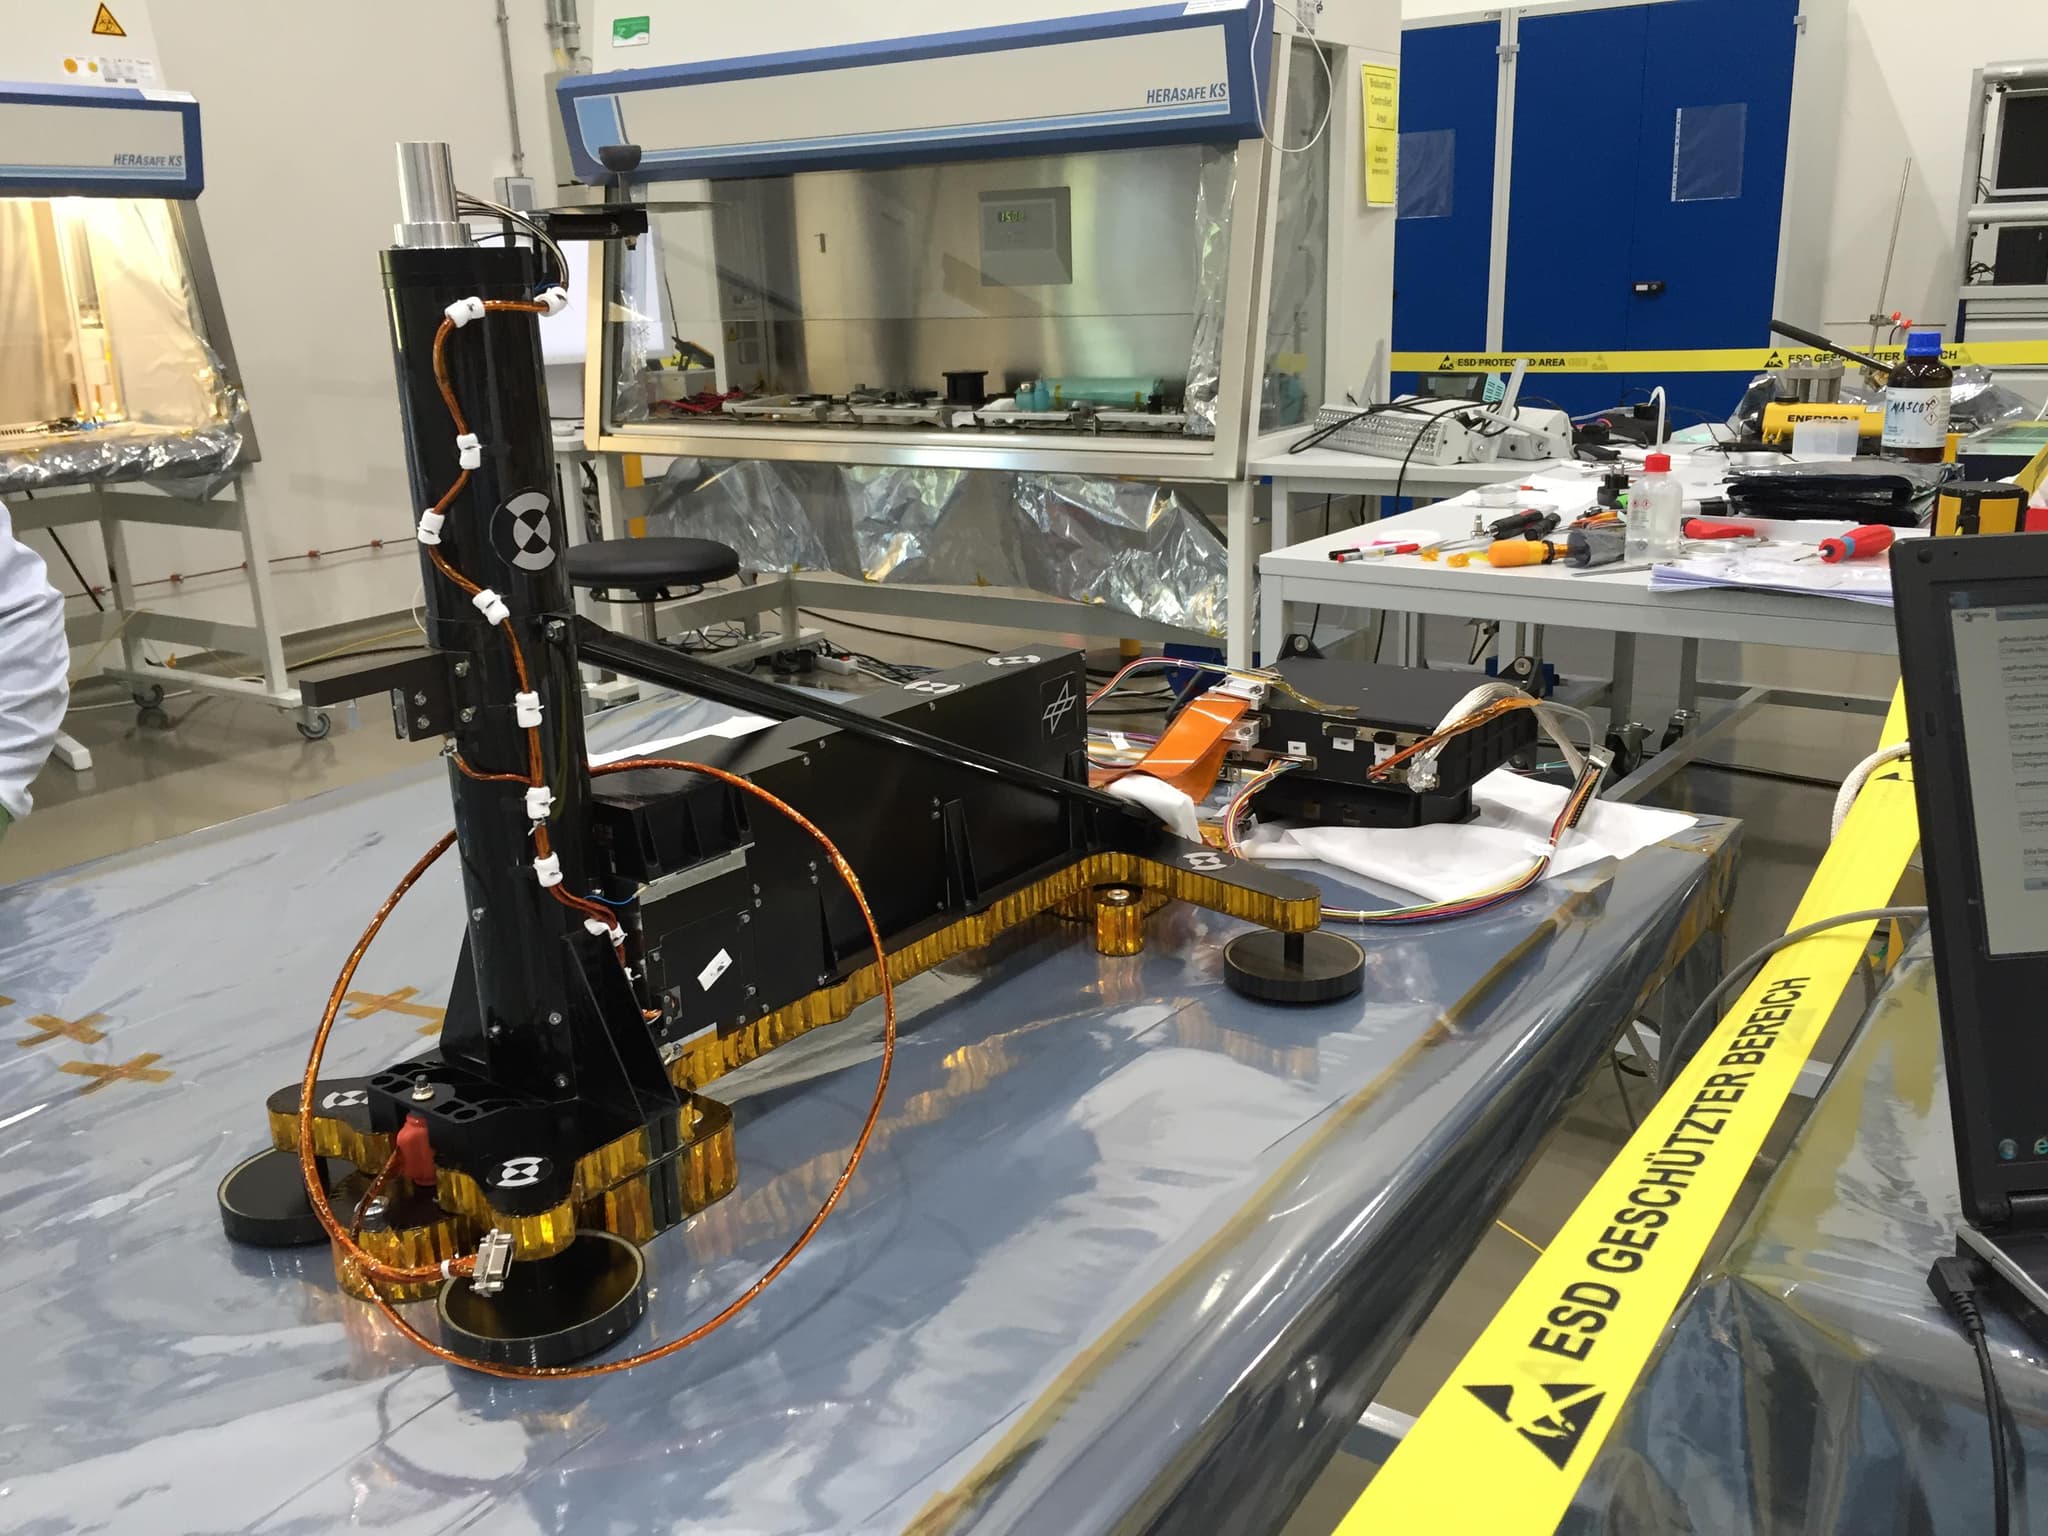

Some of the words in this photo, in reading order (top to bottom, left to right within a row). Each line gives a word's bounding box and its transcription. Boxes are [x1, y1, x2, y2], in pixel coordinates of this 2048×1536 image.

[1209, 82, 1227, 98] KS
[168, 154, 183, 167] KS
[1457, 358, 1477, 367] ESD
[1478, 358, 1536, 367] PROTECD
[1538, 358, 1566, 367] AREA
[1529, 1281, 1621, 1361] ESD
[1586, 1072, 1755, 1273] GESCHÜTZTER
[1718, 977, 1811, 1066] BEREICH
